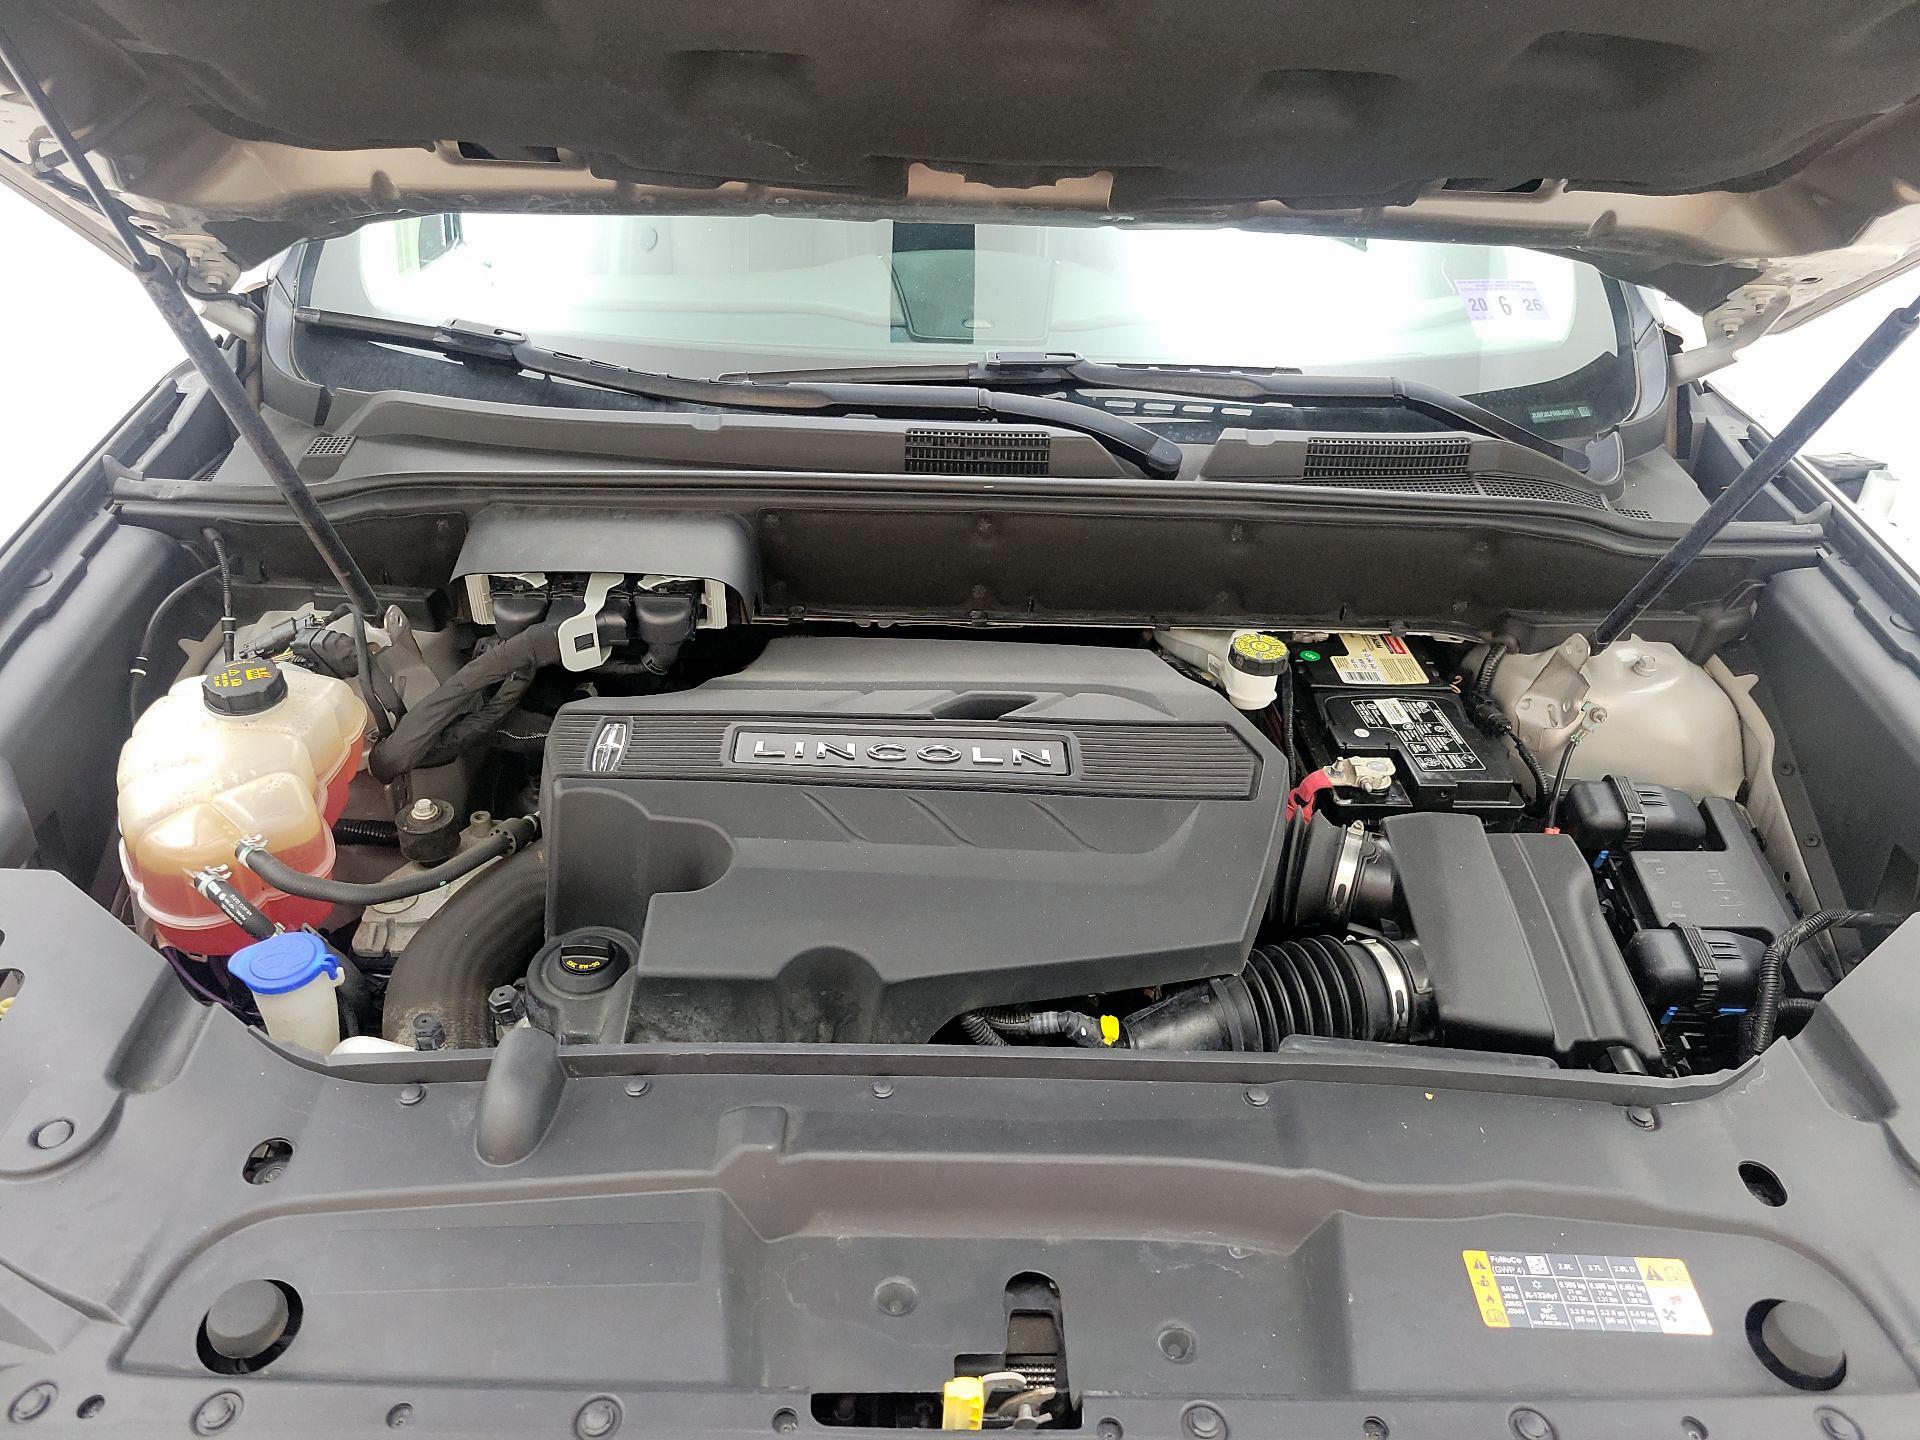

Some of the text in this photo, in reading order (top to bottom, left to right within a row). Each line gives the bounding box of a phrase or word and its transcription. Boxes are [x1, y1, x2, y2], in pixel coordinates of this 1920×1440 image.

[1468, 295, 1544, 315] 20 6 26
[754, 740, 1052, 765] LINCOLN
[1490, 1255, 1522, 1264] FoMoCo
[1492, 1265, 1516, 1274] (GWP
